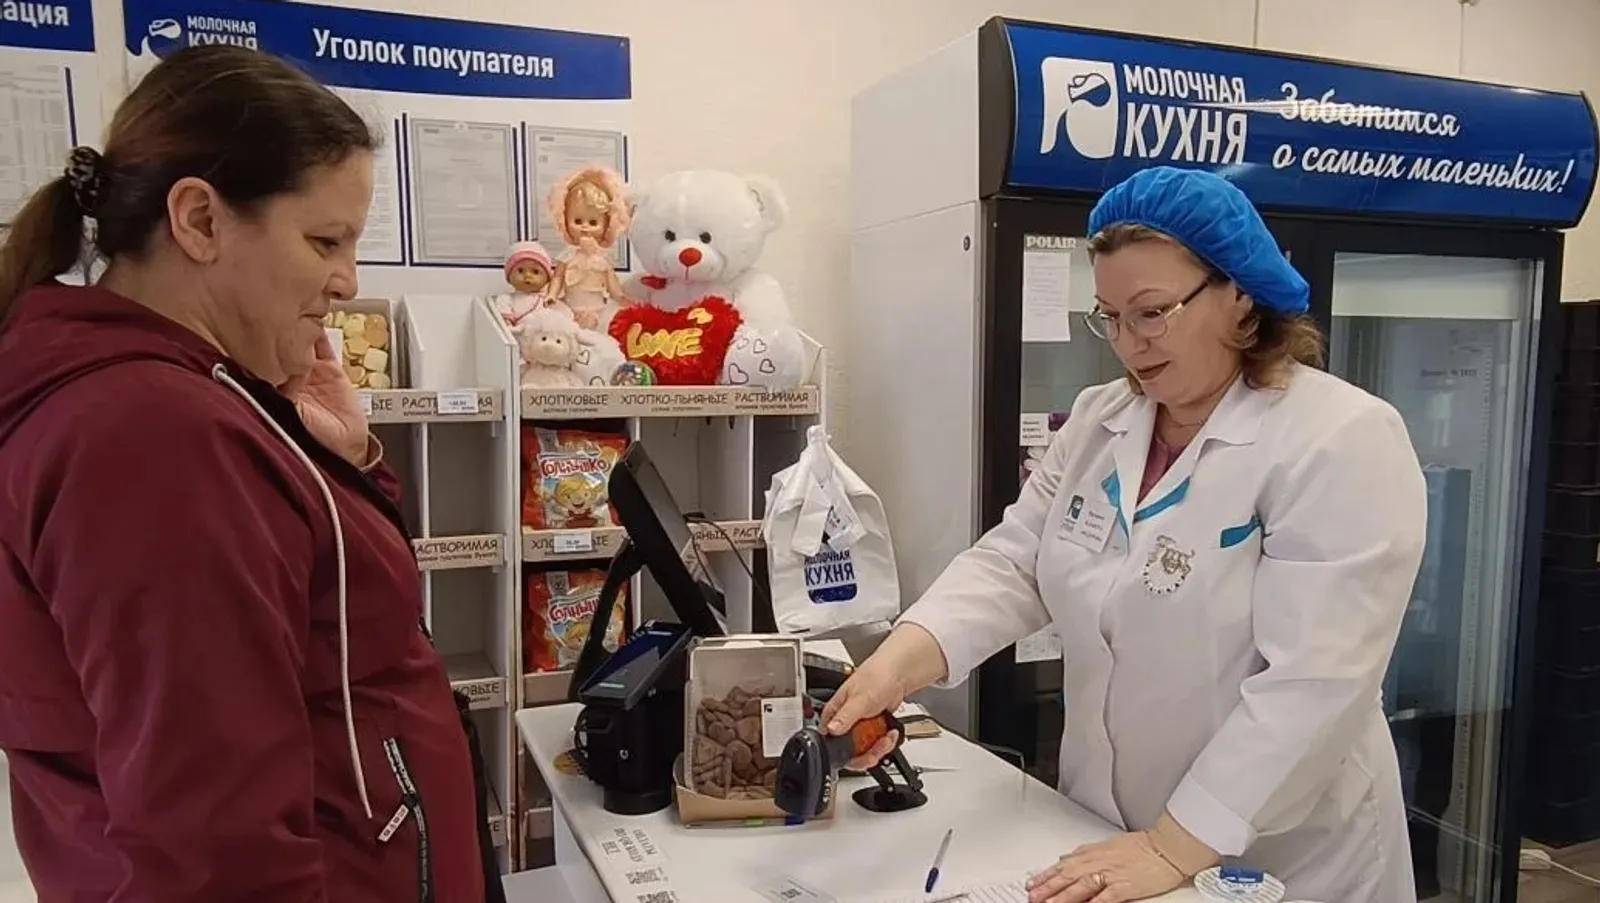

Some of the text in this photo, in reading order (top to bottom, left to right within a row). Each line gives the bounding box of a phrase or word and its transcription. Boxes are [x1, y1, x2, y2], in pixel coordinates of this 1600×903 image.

[0, 0, 69, 28] ация
[187, 15, 257, 35] МОЛОЧНАЯ
[313, 28, 554, 79] Уголок покупателя
[1123, 63, 1246, 104] МОЛОЧНАЯ
[1280, 81, 1461, 138] Заботимся
[1123, 102, 1248, 165] КУХНЯ
[1272, 143, 1576, 194] о самых маленьких!
[1026, 235, 1077, 249] POLAIR
[402, 395, 493, 409] РАСТАЯ
[529, 393, 609, 406] ХЛОПКОВЫЕ
[620, 393, 729, 405] ХЛОПКО-ЛЬНЯНЫЕ
[416, 539, 498, 555] АСТВОРИМАЯ
[804, 562, 855, 586] КУХНЯ
[455, 682, 500, 697] ОВЫЕ
